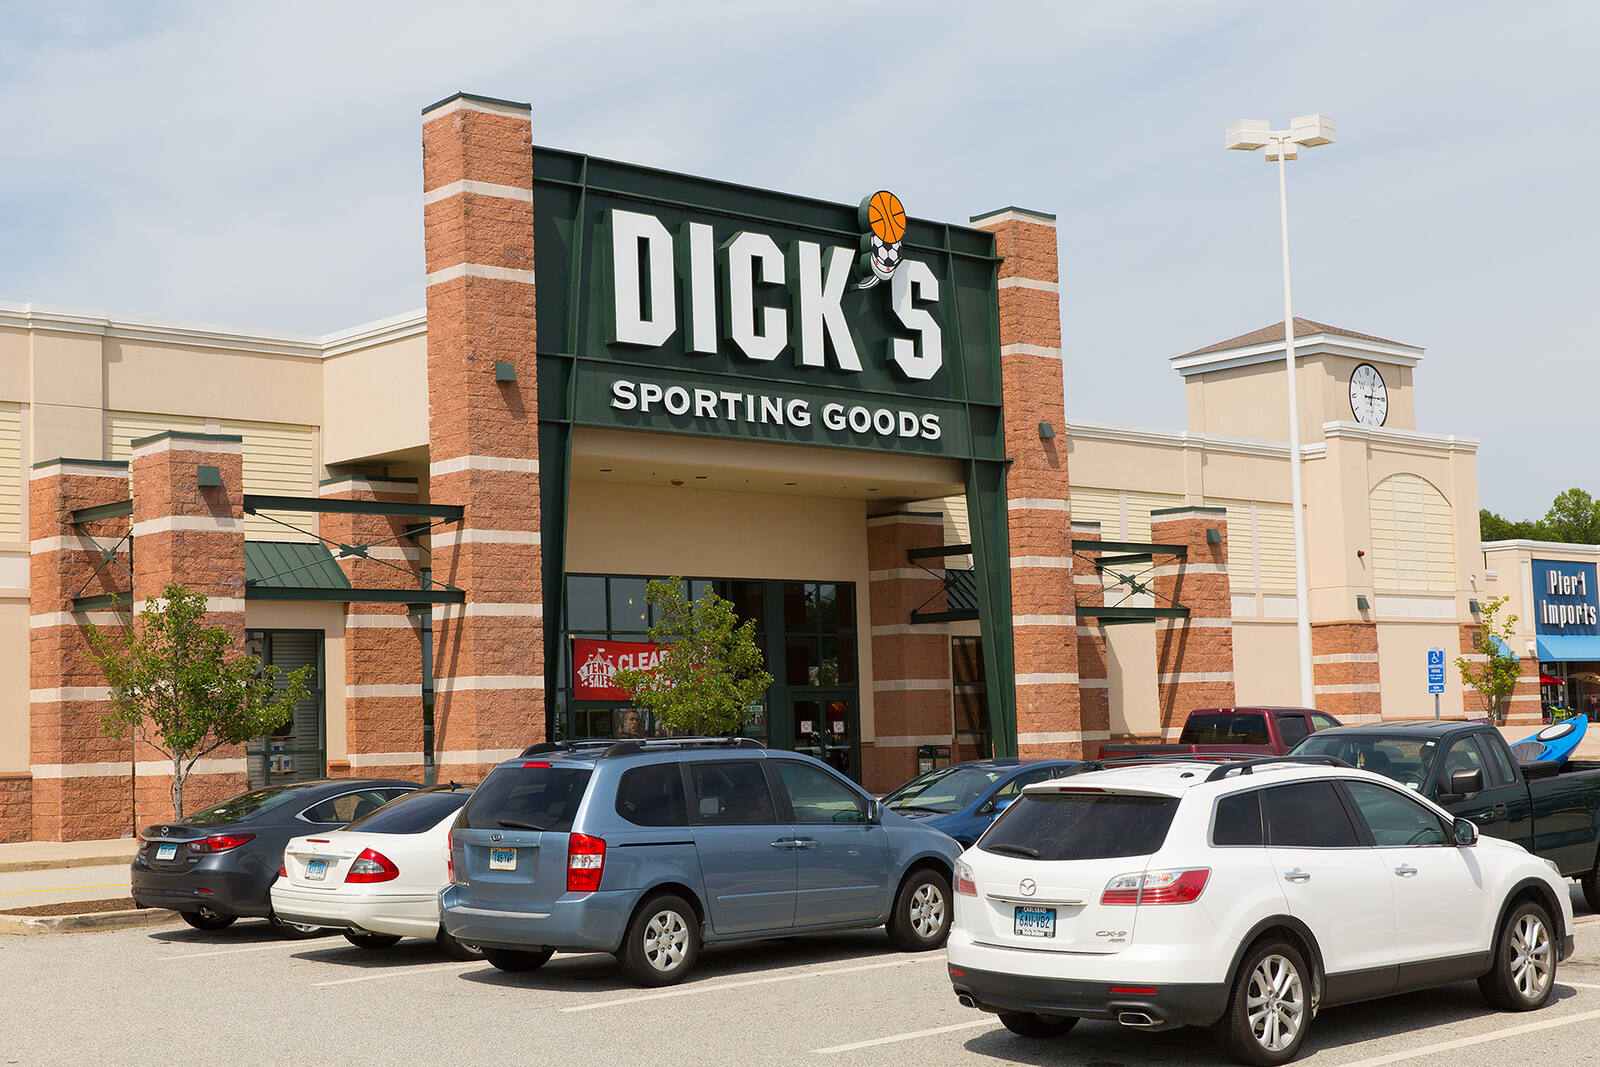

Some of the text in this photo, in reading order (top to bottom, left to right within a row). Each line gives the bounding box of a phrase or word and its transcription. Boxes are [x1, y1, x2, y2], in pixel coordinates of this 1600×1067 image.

[610, 190, 943, 381] DICK'S
[611, 380, 942, 441] SPORTING GOODS
[585, 661, 611, 675] TENT
[588, 675, 609, 688] SALE
